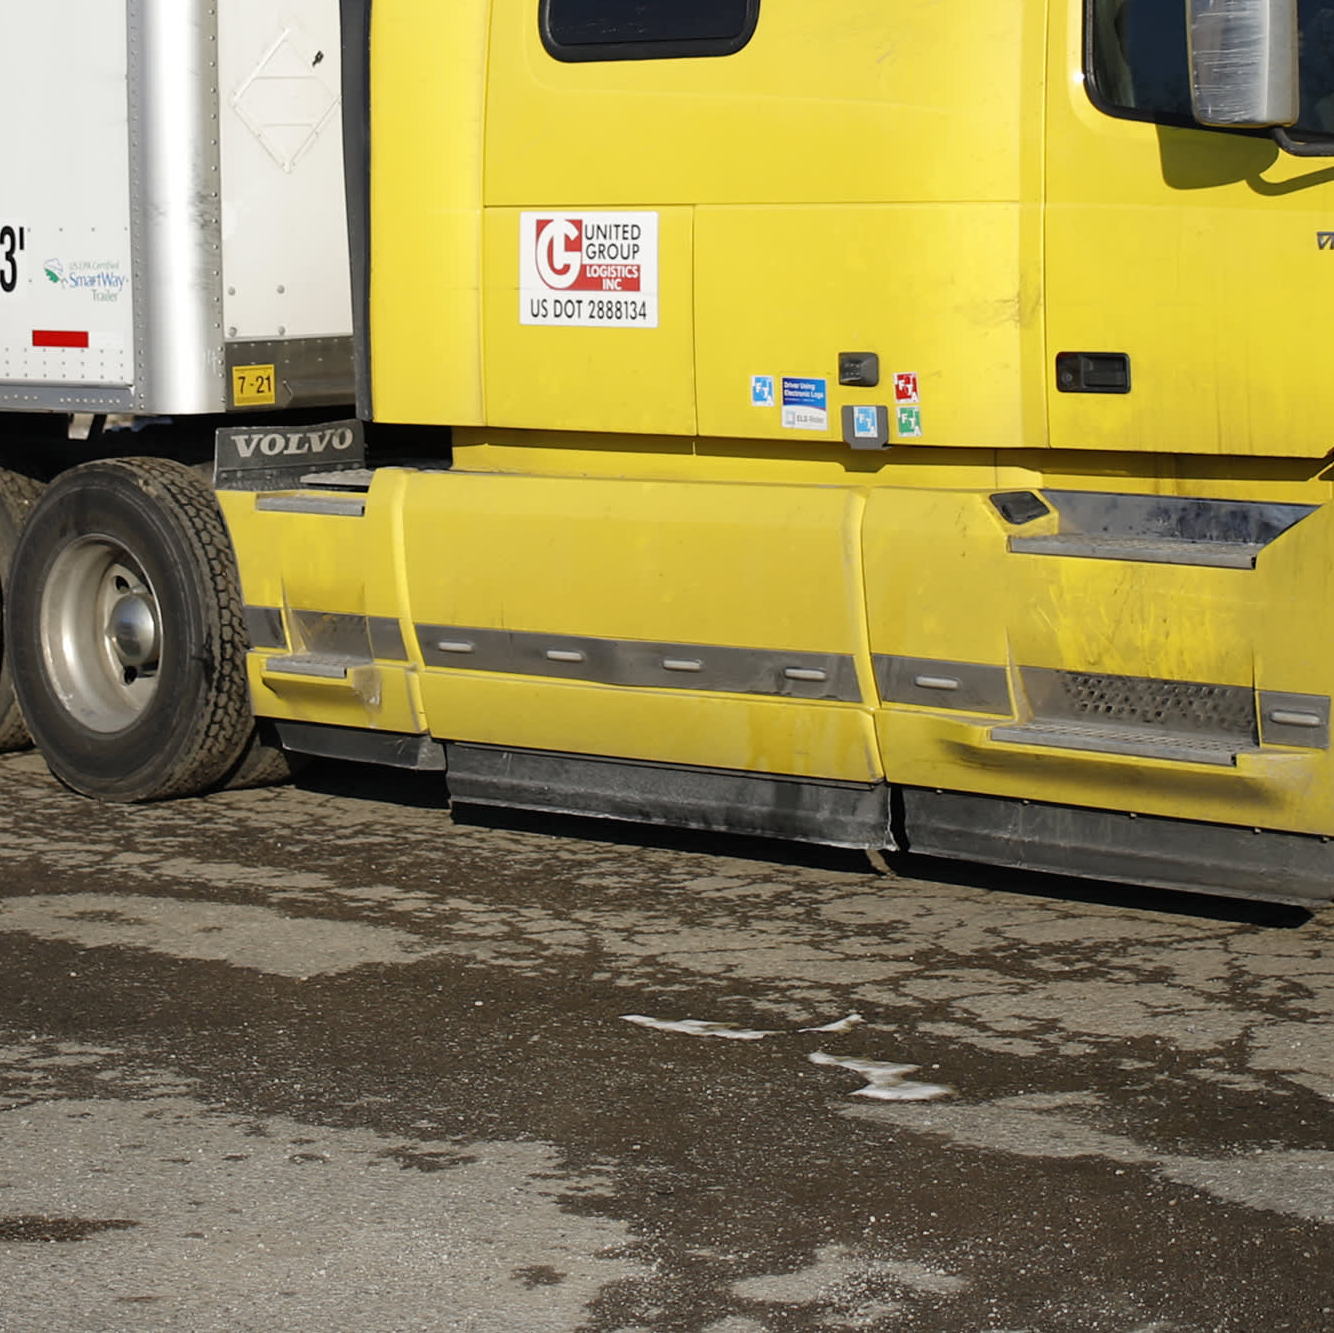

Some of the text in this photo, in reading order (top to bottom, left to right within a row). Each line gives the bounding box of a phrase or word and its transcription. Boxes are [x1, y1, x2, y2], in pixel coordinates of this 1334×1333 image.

[584, 224, 641, 240] UNITED
[585, 243, 640, 260] GROUP
[586, 265, 638, 278] LOGISTICS
[69, 271, 125, 292] SmartWay
[602, 278, 622, 291] INC
[91, 289, 119, 302] Trailer
[530, 298, 647, 320] US DOT 2888134
[230, 427, 353, 458] VOLVO
